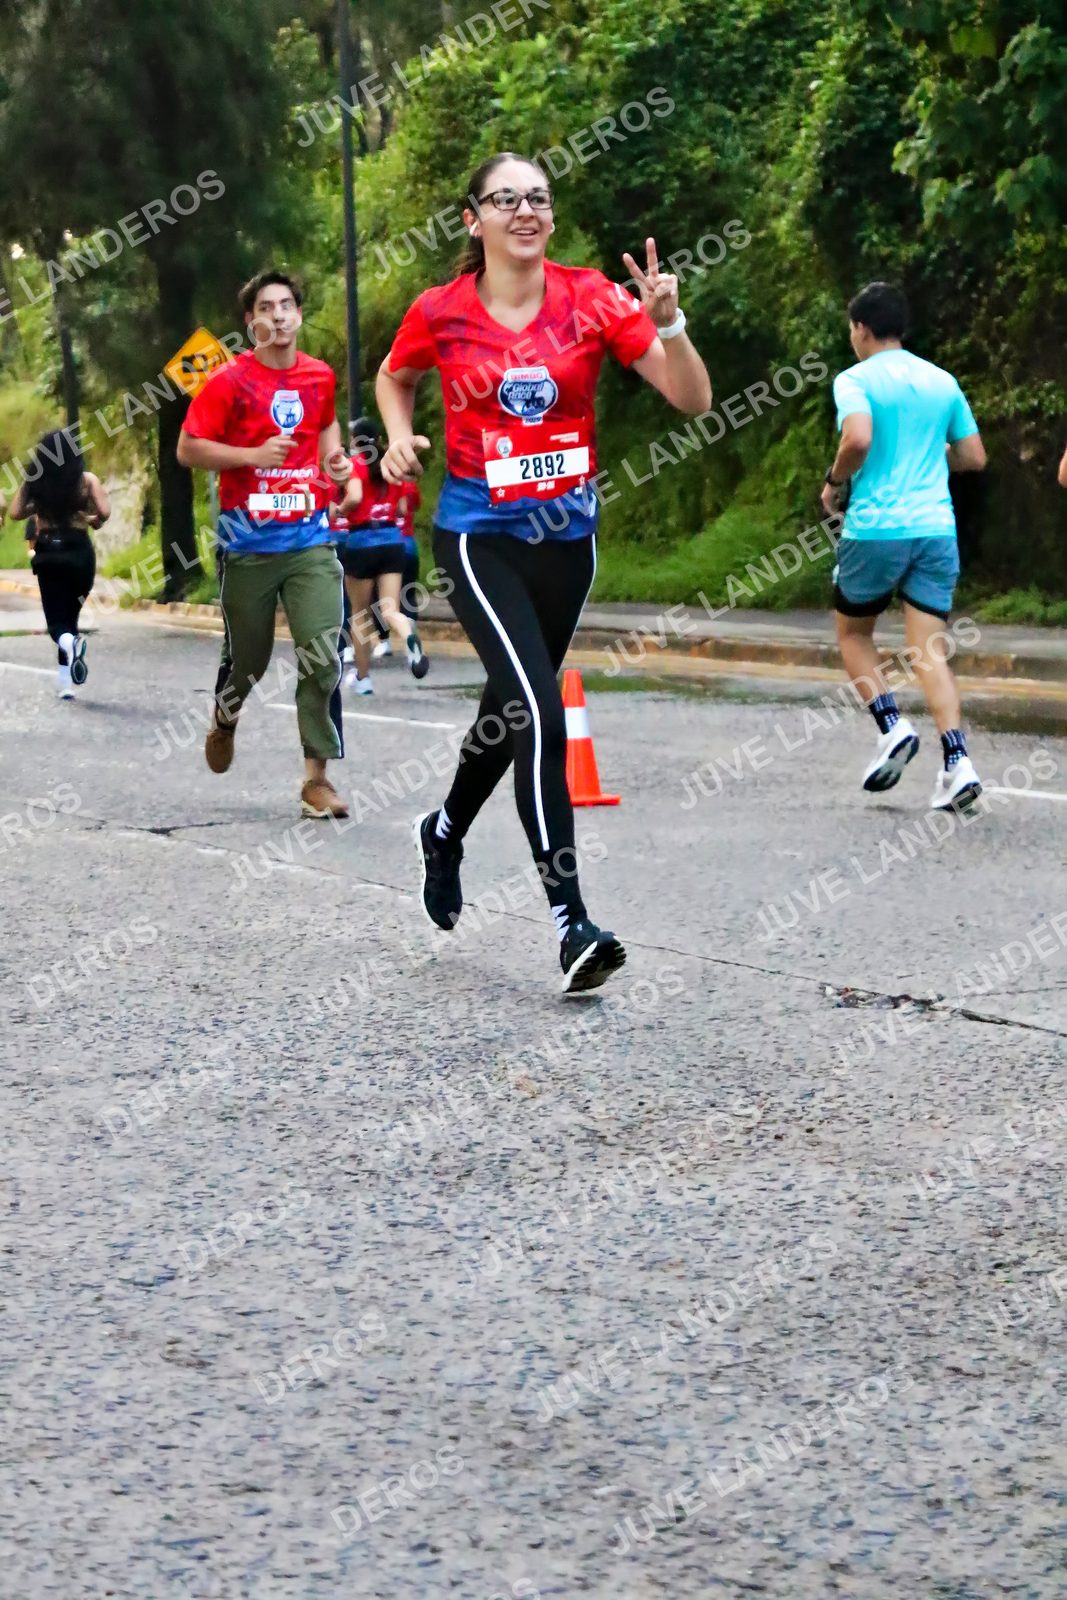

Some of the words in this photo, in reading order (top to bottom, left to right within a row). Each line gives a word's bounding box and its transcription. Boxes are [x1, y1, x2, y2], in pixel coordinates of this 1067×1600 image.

[512, 382, 544, 392] Global
[520, 453, 565, 480] 2892
[272, 495, 297, 509] 3071
